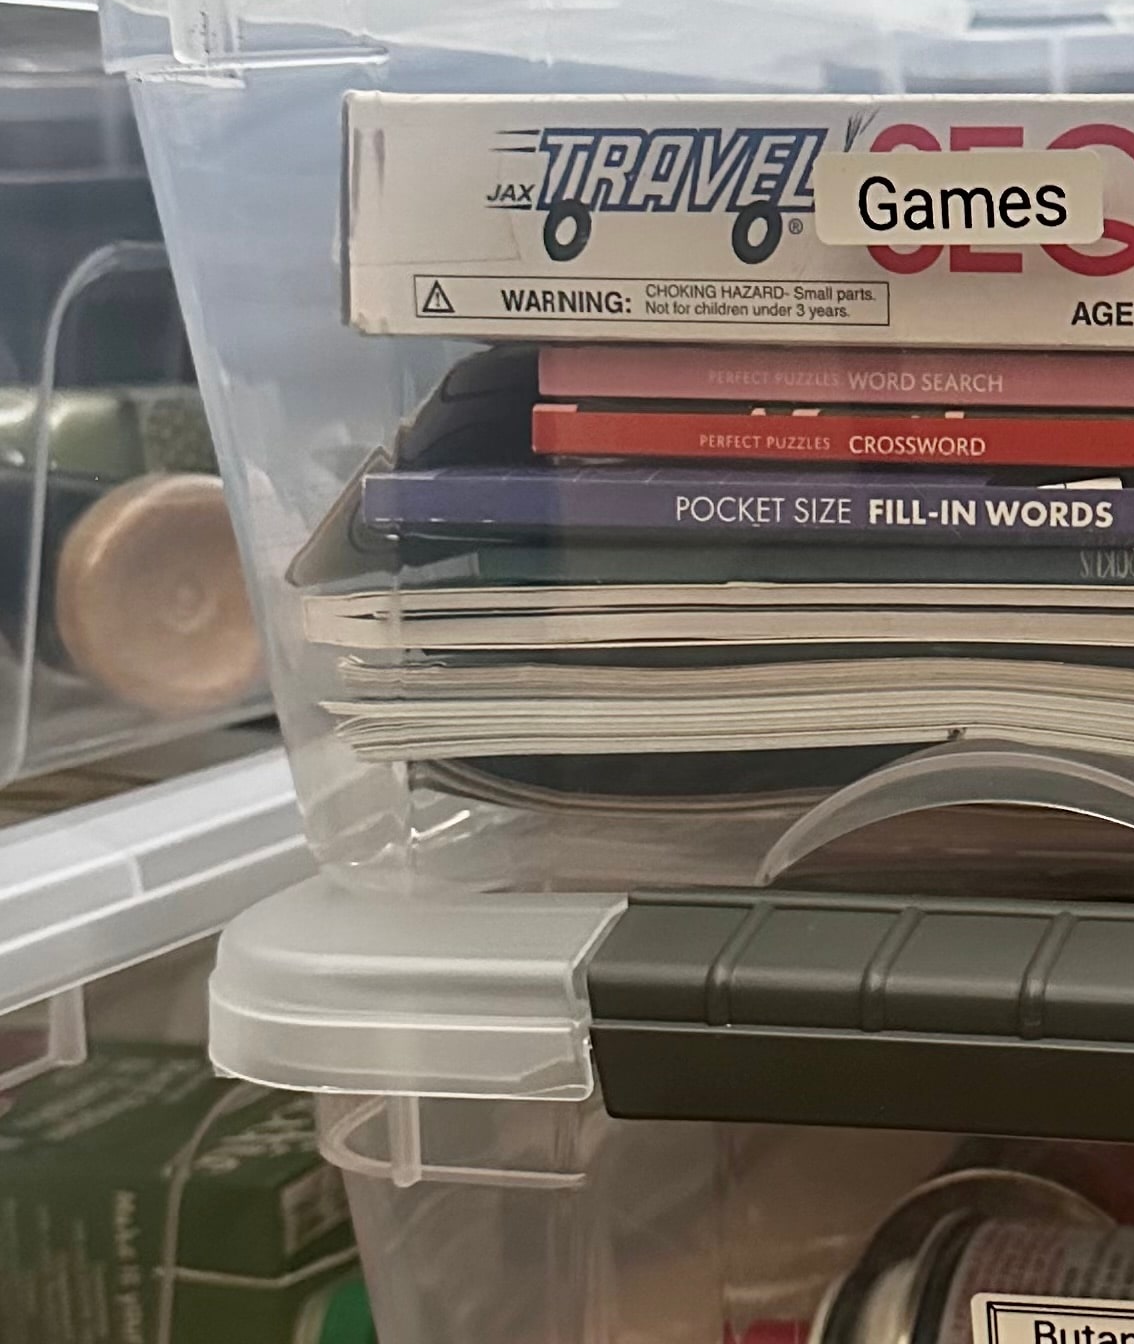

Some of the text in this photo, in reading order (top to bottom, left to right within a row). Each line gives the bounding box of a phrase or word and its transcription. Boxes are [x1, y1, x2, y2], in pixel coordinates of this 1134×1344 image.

[535, 128, 828, 212] TRAVEL
[487, 183, 534, 202] JAX
[858, 175, 1067, 231] Games
[501, 289, 632, 314] WARNING:
[645, 284, 717, 299] CHOKING
[793, 286, 833, 301] Small
[837, 288, 877, 303] parts.
[645, 302, 850, 320] Not for children under 3 years.
[848, 372, 916, 391] WORD
[920, 373, 1005, 393] SEARCH
[699, 434, 986, 457] PERFECT PUZZLES CROSSWORD
[676, 495, 1114, 528] POCKET SIZE FILL-IN WORDS
